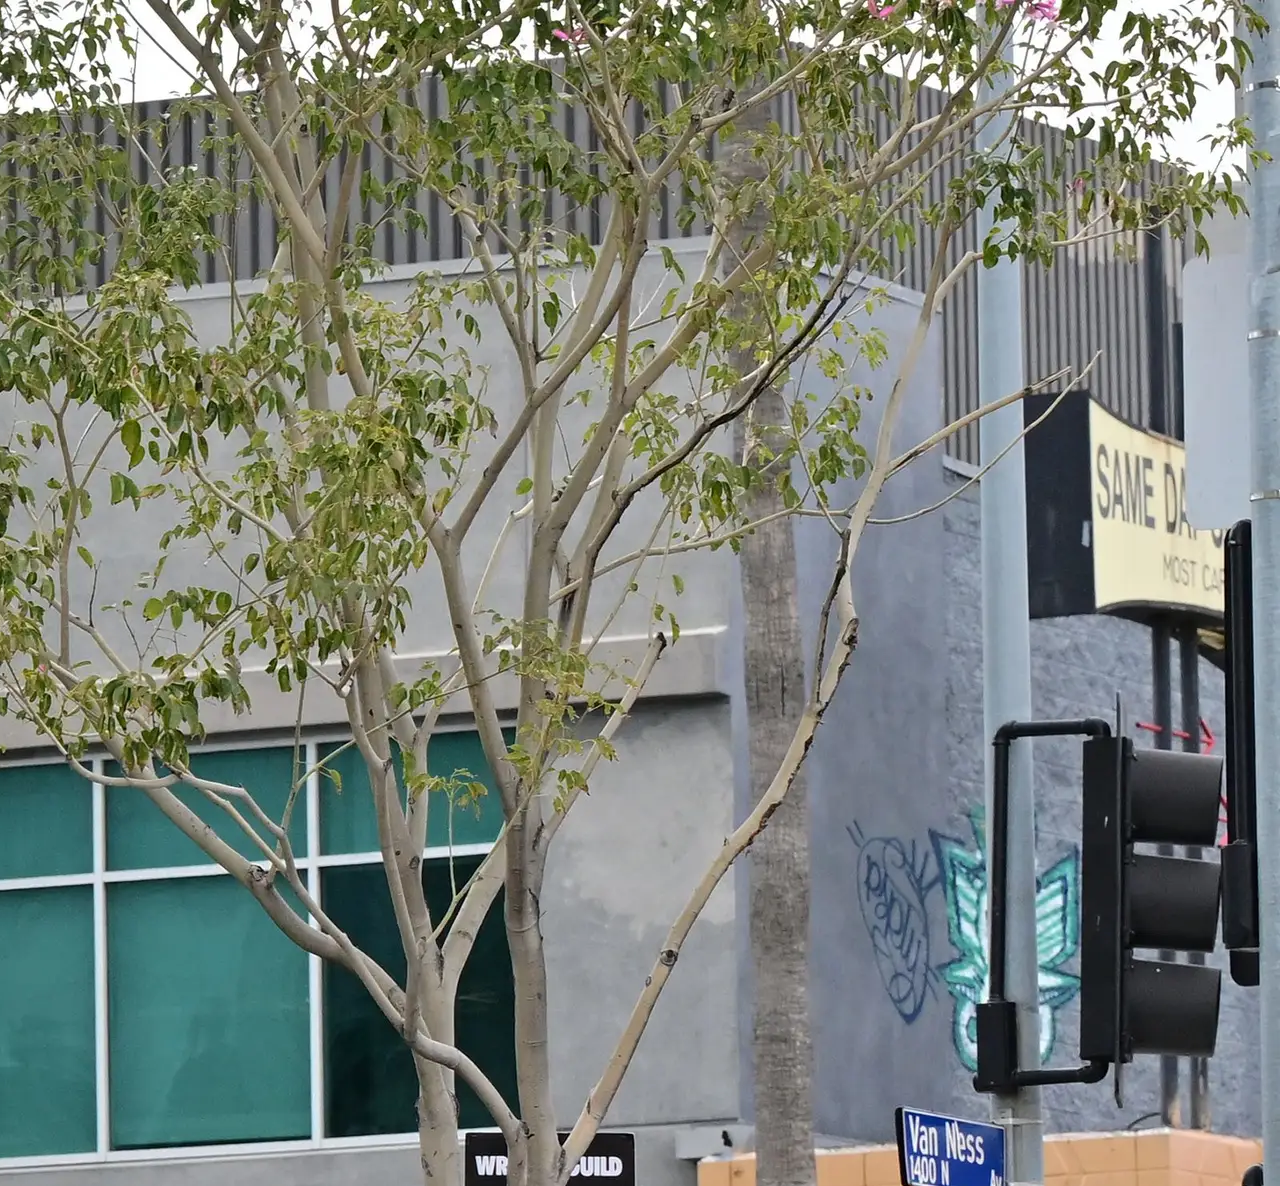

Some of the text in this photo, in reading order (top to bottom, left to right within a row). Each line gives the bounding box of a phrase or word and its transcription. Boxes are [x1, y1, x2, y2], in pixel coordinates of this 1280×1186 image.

[1097, 443, 1197, 541] SAME DA
[1163, 552, 1197, 586] MOST
[909, 1115, 985, 1165] Van Ness
[909, 1156, 950, 1186] 1400 N
